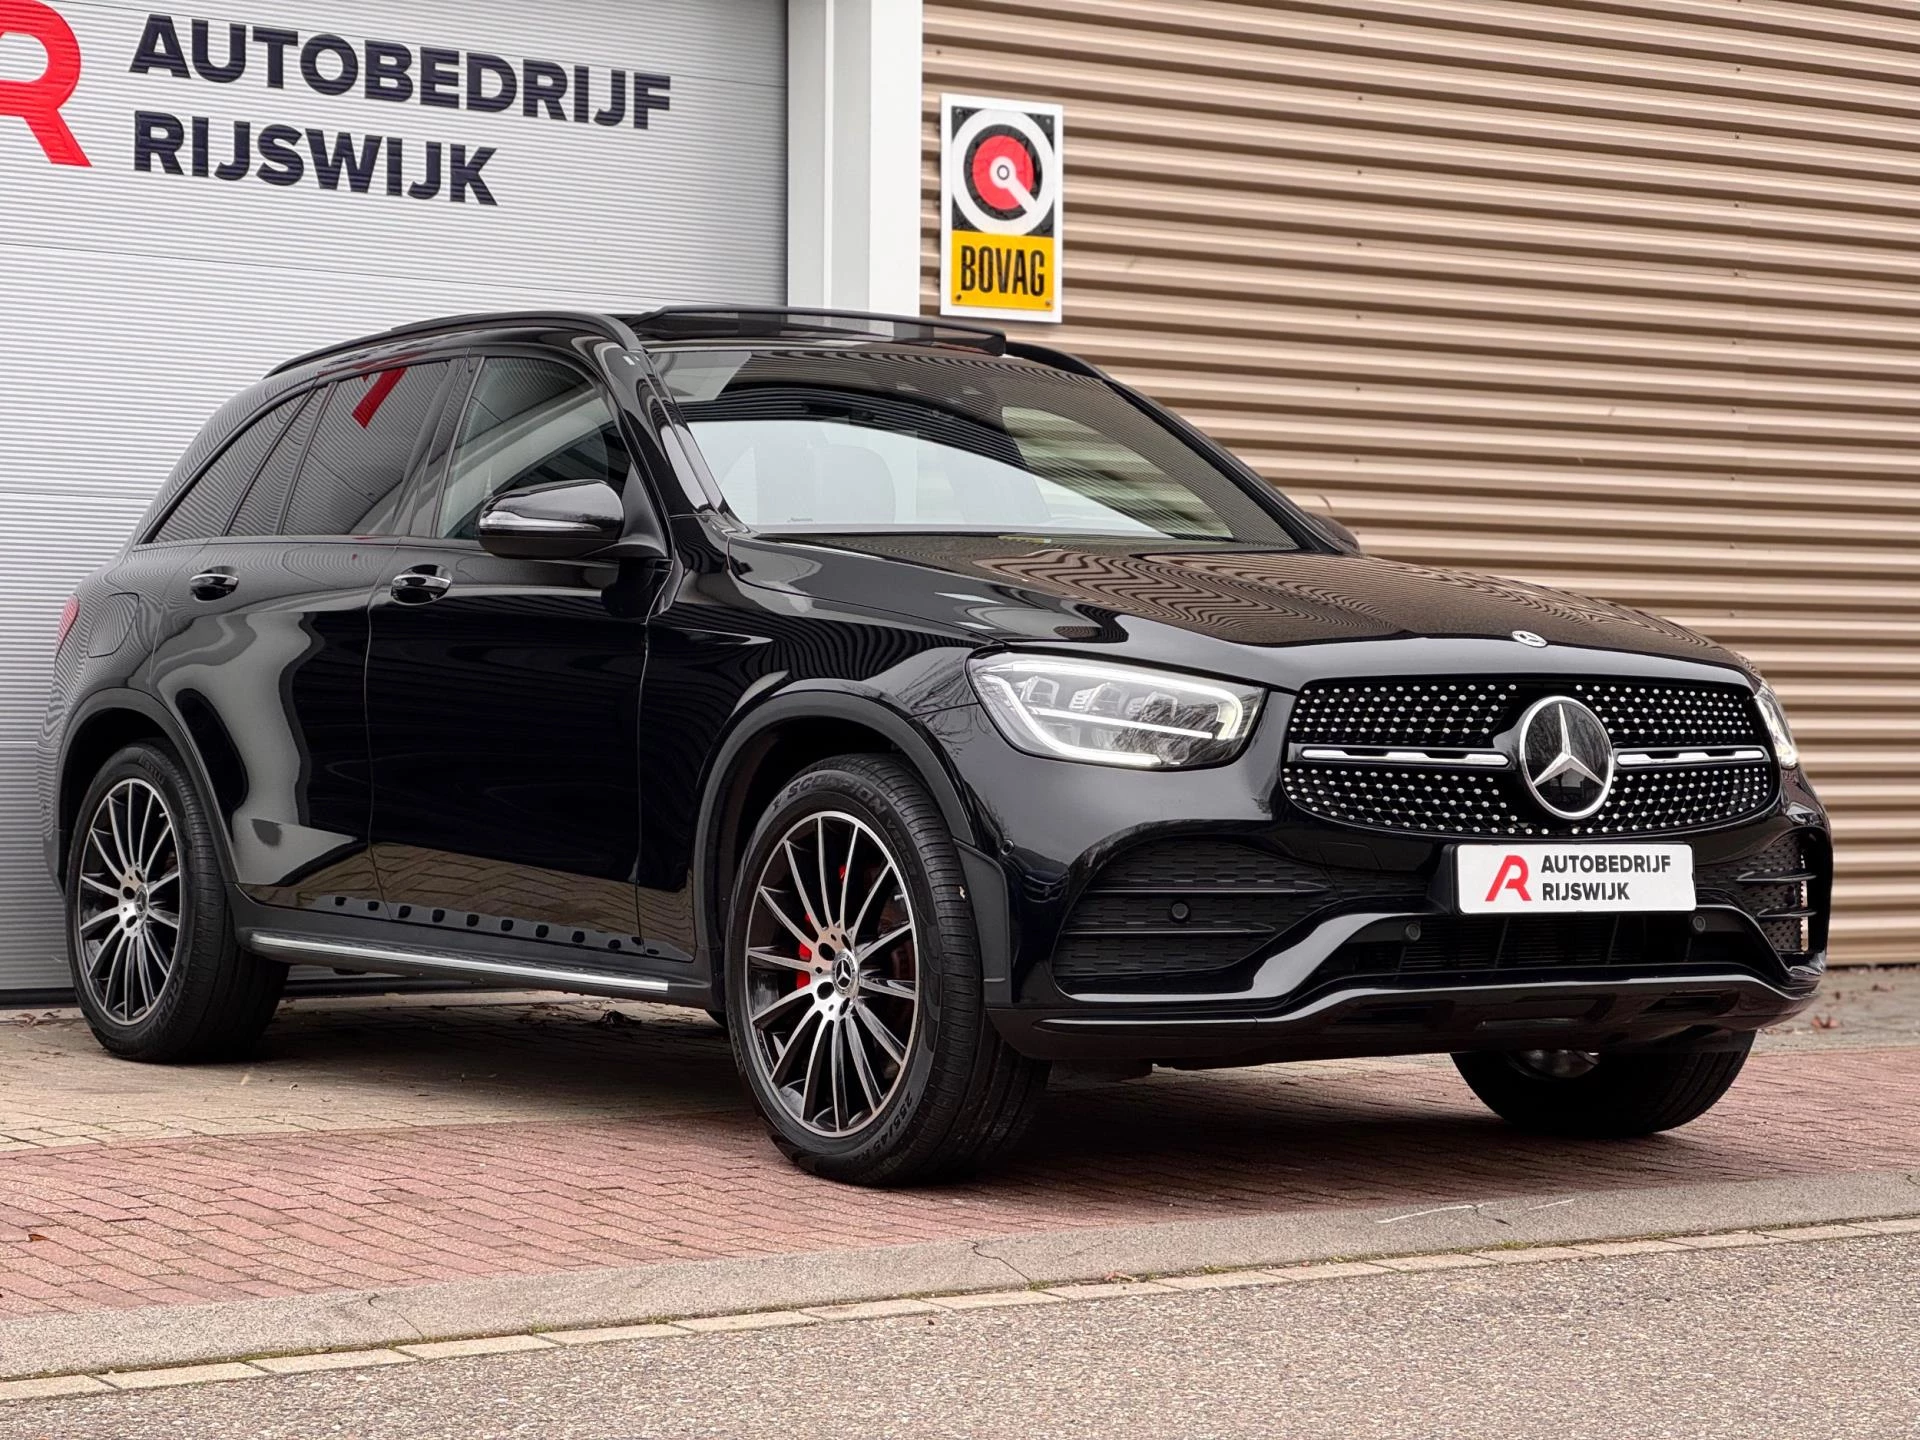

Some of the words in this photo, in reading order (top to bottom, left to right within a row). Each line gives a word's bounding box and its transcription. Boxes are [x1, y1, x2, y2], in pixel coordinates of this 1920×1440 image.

[129, 14, 671, 130] AUTOBEDRIJF
[133, 110, 498, 207] RIJSWIJK
[961, 245, 1045, 297] BOVAG
[1541, 854, 1671, 873] AUTOBEDRIJF
[1542, 882, 1630, 901] RIJSWIJK
